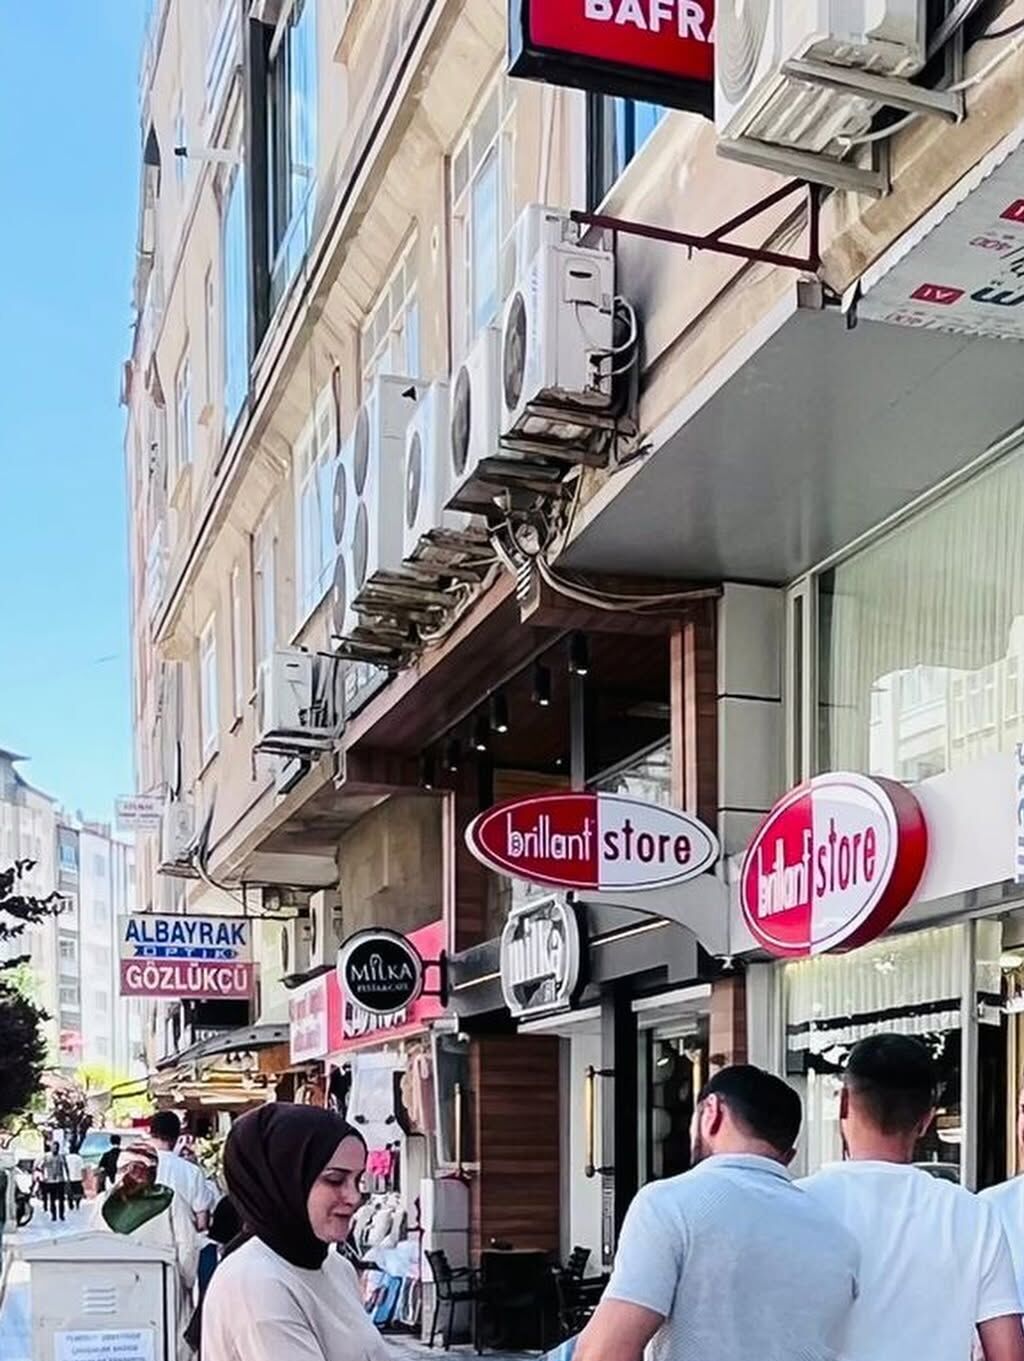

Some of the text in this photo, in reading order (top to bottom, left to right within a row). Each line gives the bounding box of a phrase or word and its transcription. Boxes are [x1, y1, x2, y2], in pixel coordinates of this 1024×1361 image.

[574, 0, 715, 43] BAFR
[507, 812, 692, 865] brillant store
[816, 819, 877, 897] store
[125, 919, 247, 946] ALBAYRAK
[126, 961, 248, 994] GÖZLÜKÇÜ
